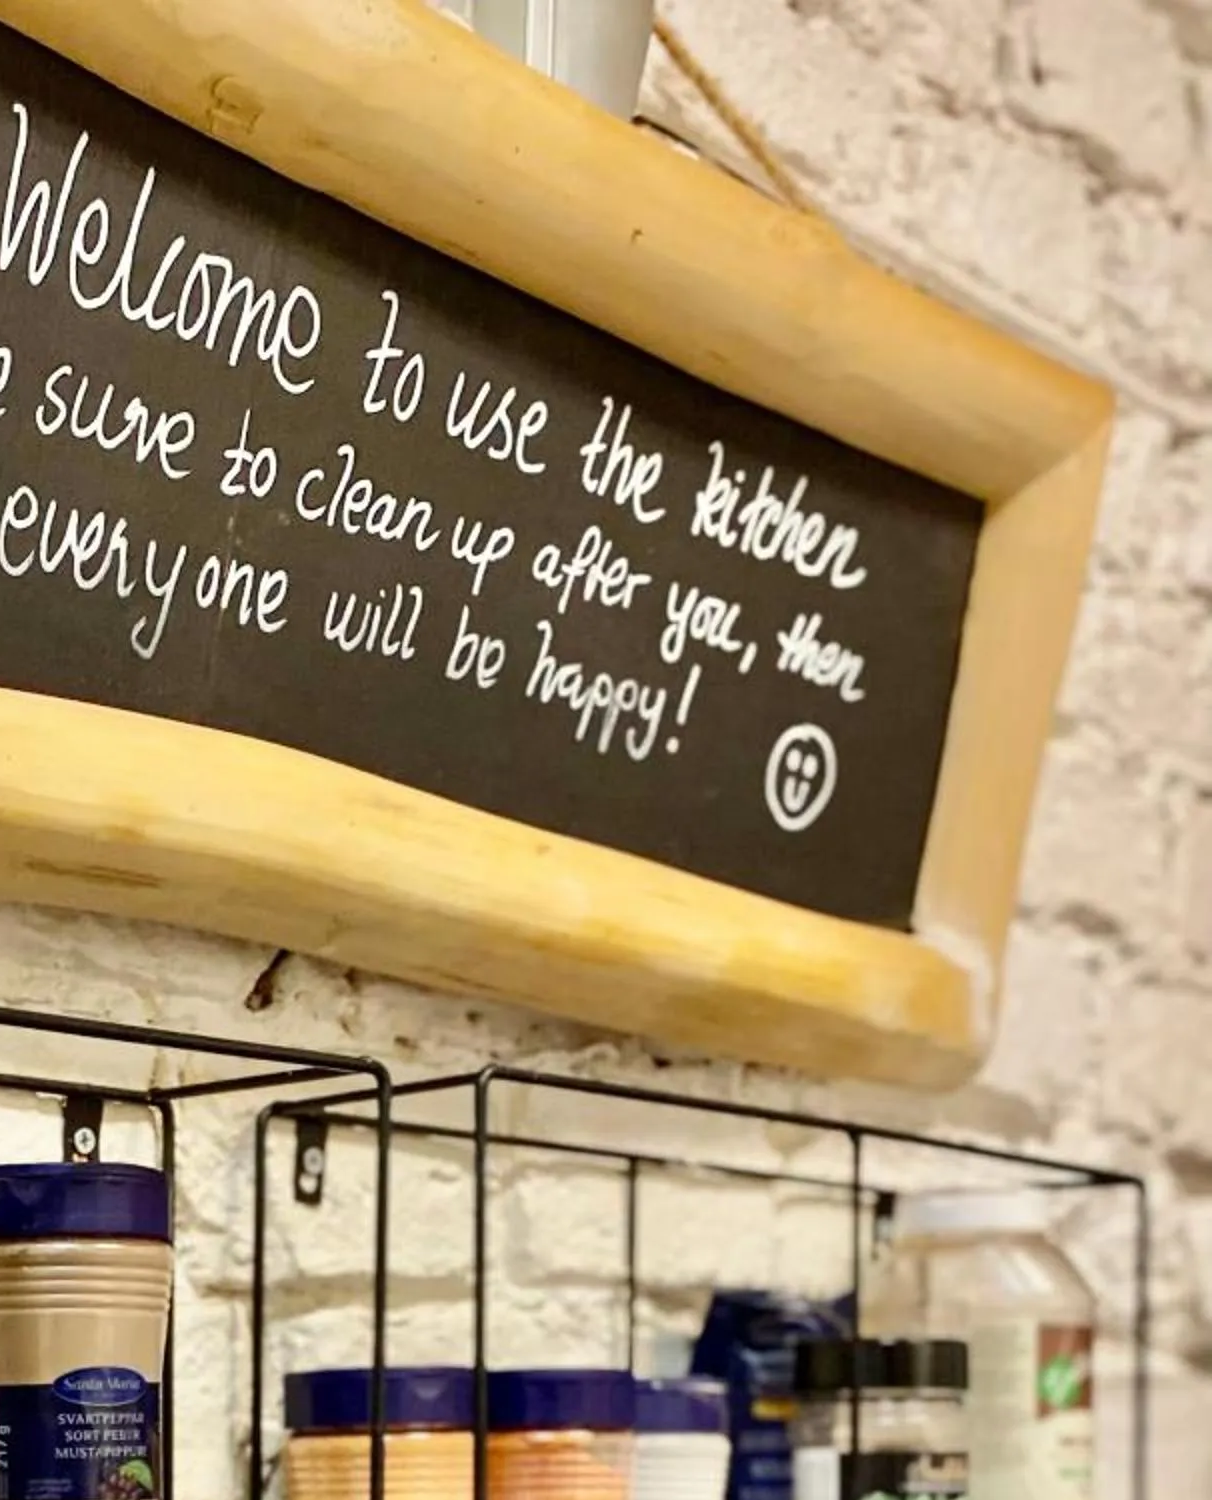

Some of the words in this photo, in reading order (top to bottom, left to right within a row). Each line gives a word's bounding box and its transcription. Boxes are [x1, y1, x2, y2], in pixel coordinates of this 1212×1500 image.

[35, 364, 196, 480] sure
[220, 407, 279, 498] to
[295, 444, 441, 552] clean
[451, 514, 516, 596] up
[532, 525, 653, 613] after
[659, 581, 759, 675] you,
[776, 612, 866, 704] then
[363, 290, 427, 422] to
[445, 371, 549, 474] use
[579, 395, 666, 522] the
[690, 439, 867, 589] kitchen
[323, 581, 424, 661] will
[445, 605, 507, 689] be
[525, 619, 702, 762] happy!
